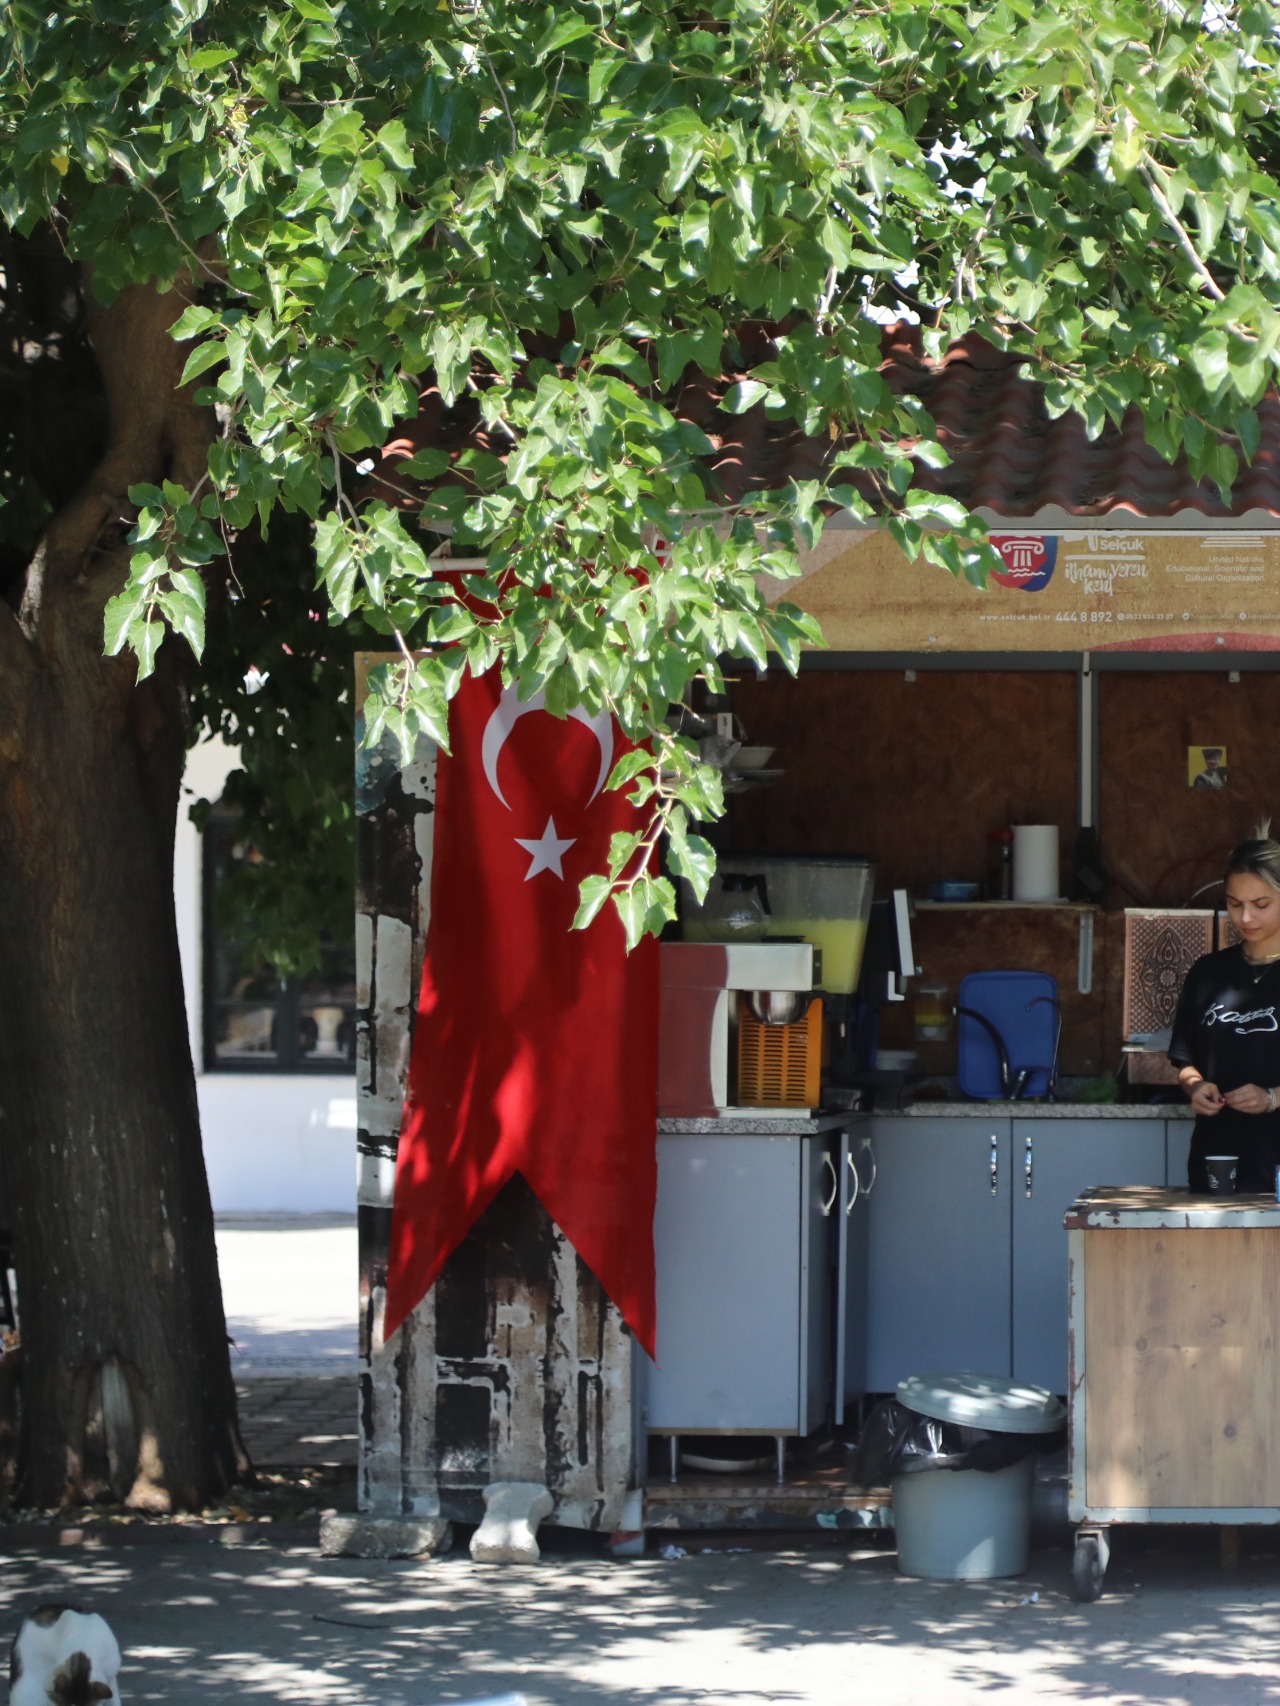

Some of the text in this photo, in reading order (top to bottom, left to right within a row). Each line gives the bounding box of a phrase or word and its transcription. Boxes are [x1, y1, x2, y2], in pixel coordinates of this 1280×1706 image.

[1100, 538, 1144, 554] Selçuk
[1235, 556, 1265, 564] Nations
[1249, 565, 1265, 573] and
[1185, 574, 1215, 582] Cultural
[1055, 612, 1112, 623] 444 8 892
